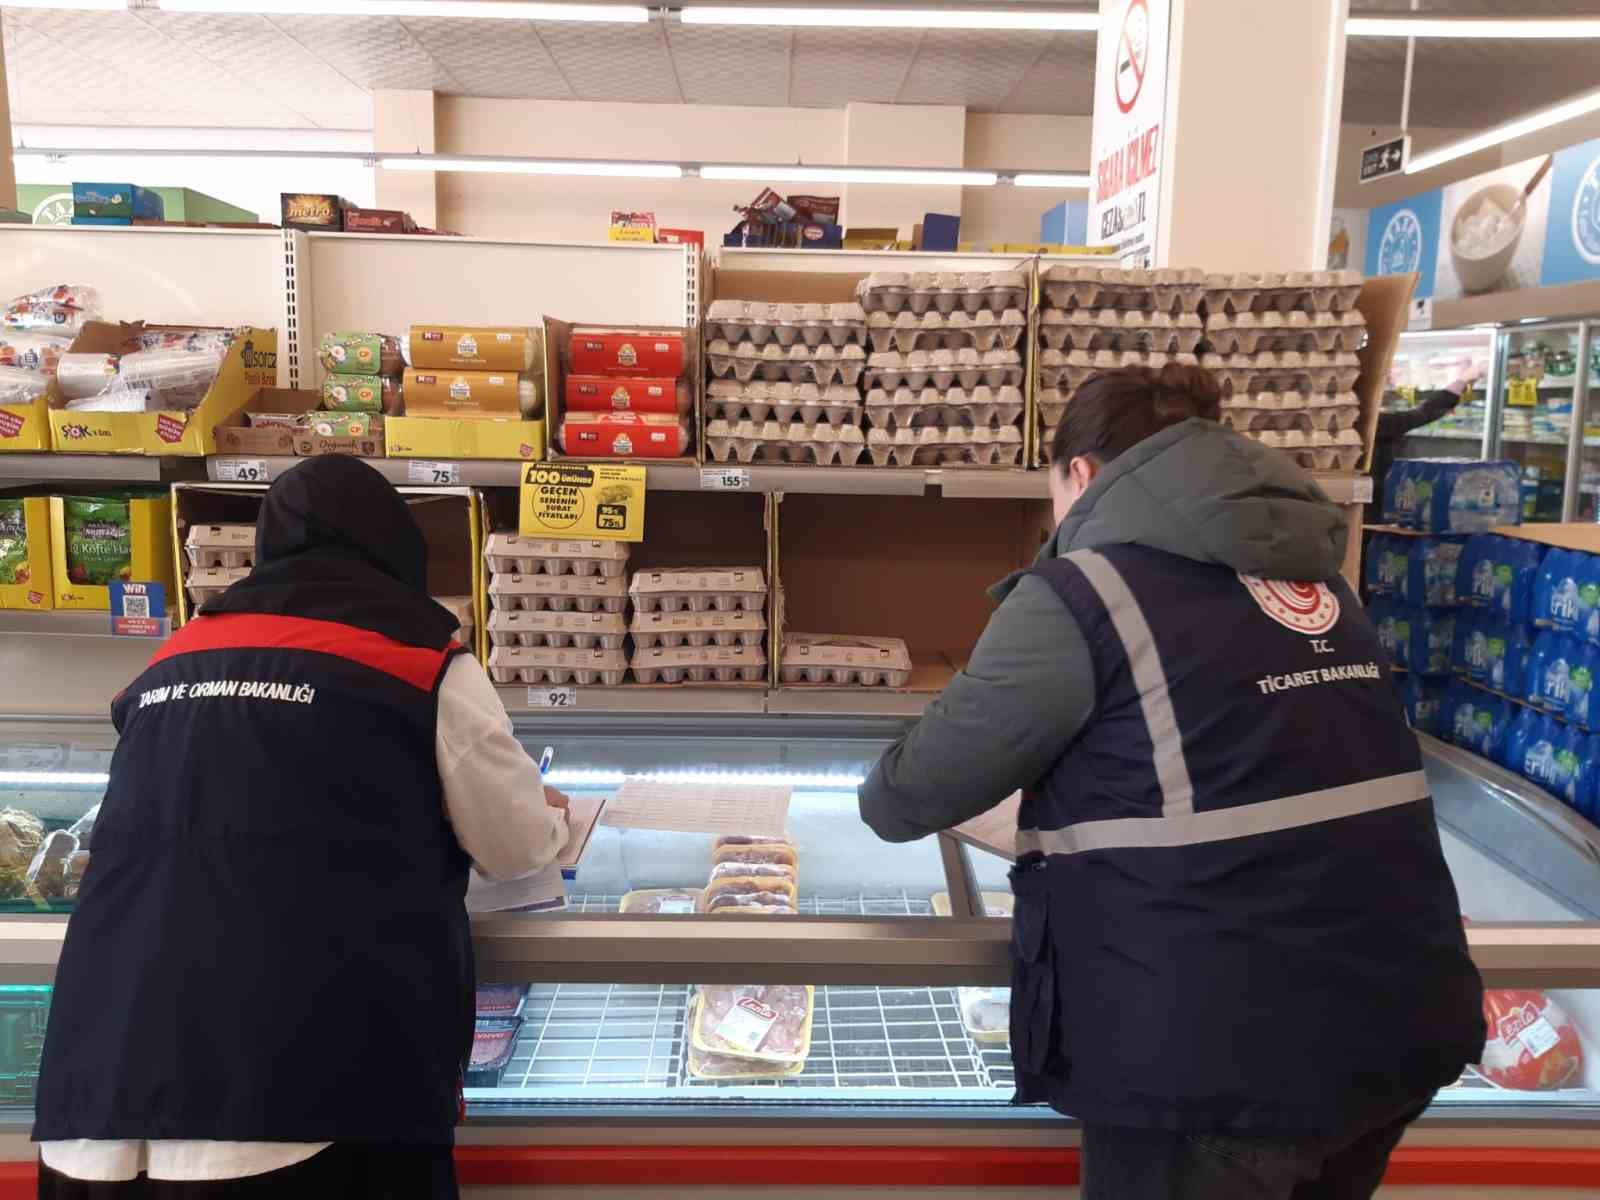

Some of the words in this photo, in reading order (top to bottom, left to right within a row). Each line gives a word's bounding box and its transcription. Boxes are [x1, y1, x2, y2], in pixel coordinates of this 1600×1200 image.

[238, 467, 258, 481] 49
[432, 470, 450, 483] 75
[529, 470, 560, 484] 100
[722, 476, 741, 487] 155
[1309, 639, 1335, 654] T.C.
[1256, 670, 1320, 695] TİCARET
[1320, 661, 1380, 682] BAKANLIĞI
[138, 686, 170, 709] TARIM
[171, 682, 189, 700] VE
[188, 680, 239, 698] ORMAN
[238, 682, 316, 705] BAKANLIĞI
[549, 692, 567, 706] 92
